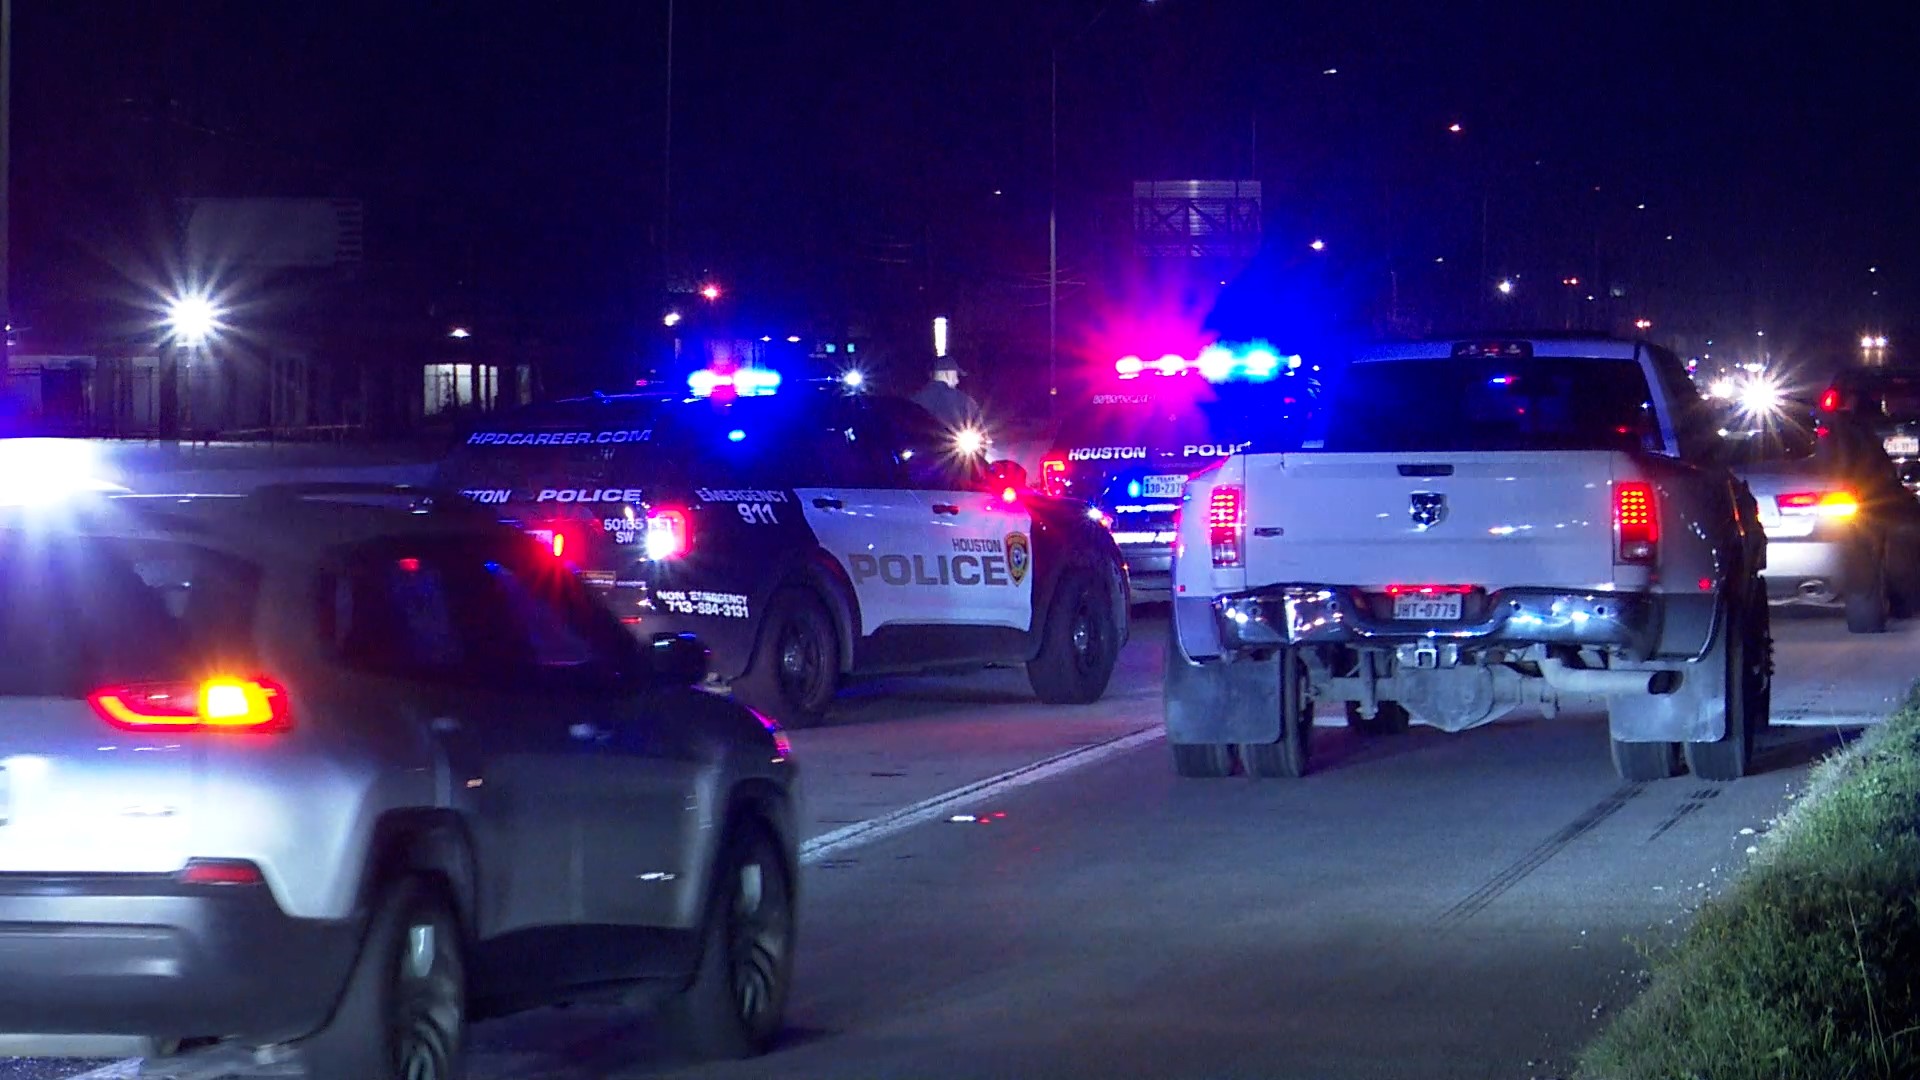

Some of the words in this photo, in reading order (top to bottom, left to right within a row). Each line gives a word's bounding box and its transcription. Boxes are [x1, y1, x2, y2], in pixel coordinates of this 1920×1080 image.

[467, 430, 652, 445] HPDCAREER.COM
[1068, 446, 1147, 461] HOUSTON
[1183, 443, 1248, 457] POLI
[536, 489, 643, 502] POLICE
[695, 489, 788, 503] EMERGENCY
[737, 503, 779, 524] 911
[616, 531, 634, 543] SW
[952, 538, 1002, 553] HOUSTON
[848, 554, 1008, 586] POLICE
[656, 591, 686, 601] NON
